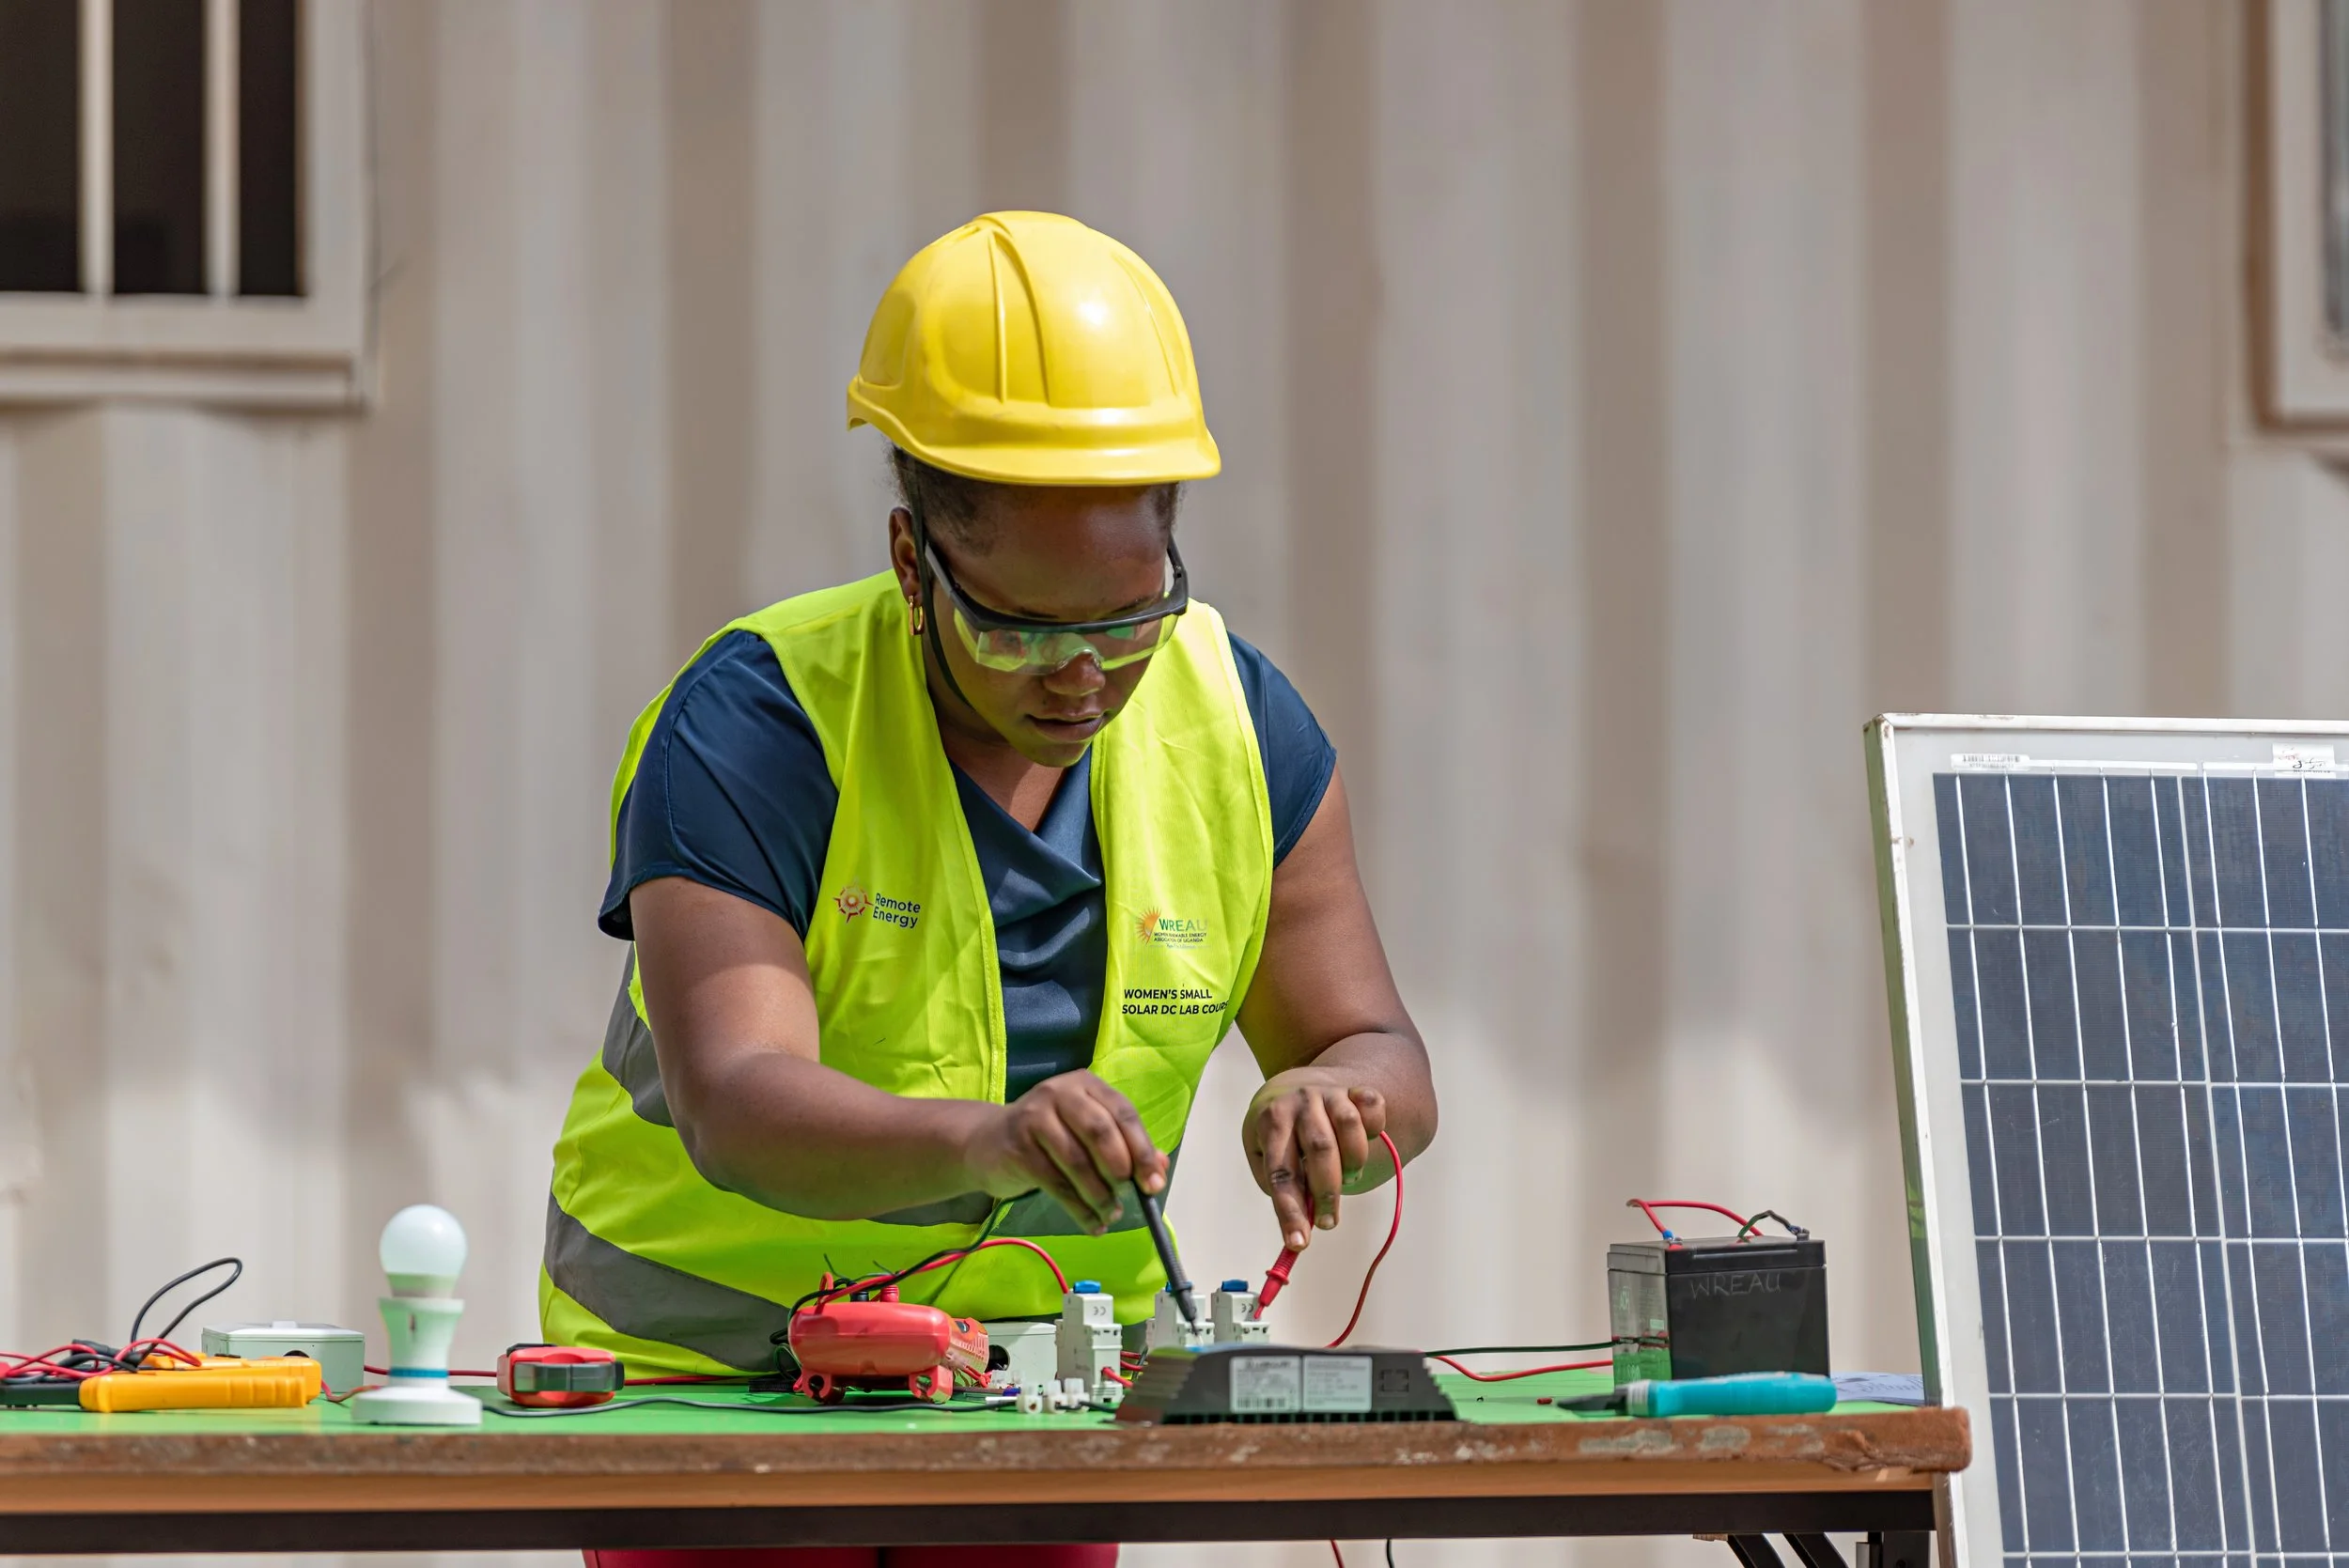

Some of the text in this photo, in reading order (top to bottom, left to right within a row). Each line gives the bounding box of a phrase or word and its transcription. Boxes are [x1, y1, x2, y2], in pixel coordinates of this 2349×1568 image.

[875, 893, 921, 913] Remote
[872, 907, 918, 929] Energy
[1159, 918, 1208, 932] WREAU
[1124, 989, 1213, 1000] WOMEN'S SMALL
[1122, 1004, 1159, 1015] SOLAR
[1160, 1004, 1177, 1015] DC
[1179, 1004, 1200, 1015] LAB
[1689, 1271, 1781, 1300] WREAU
